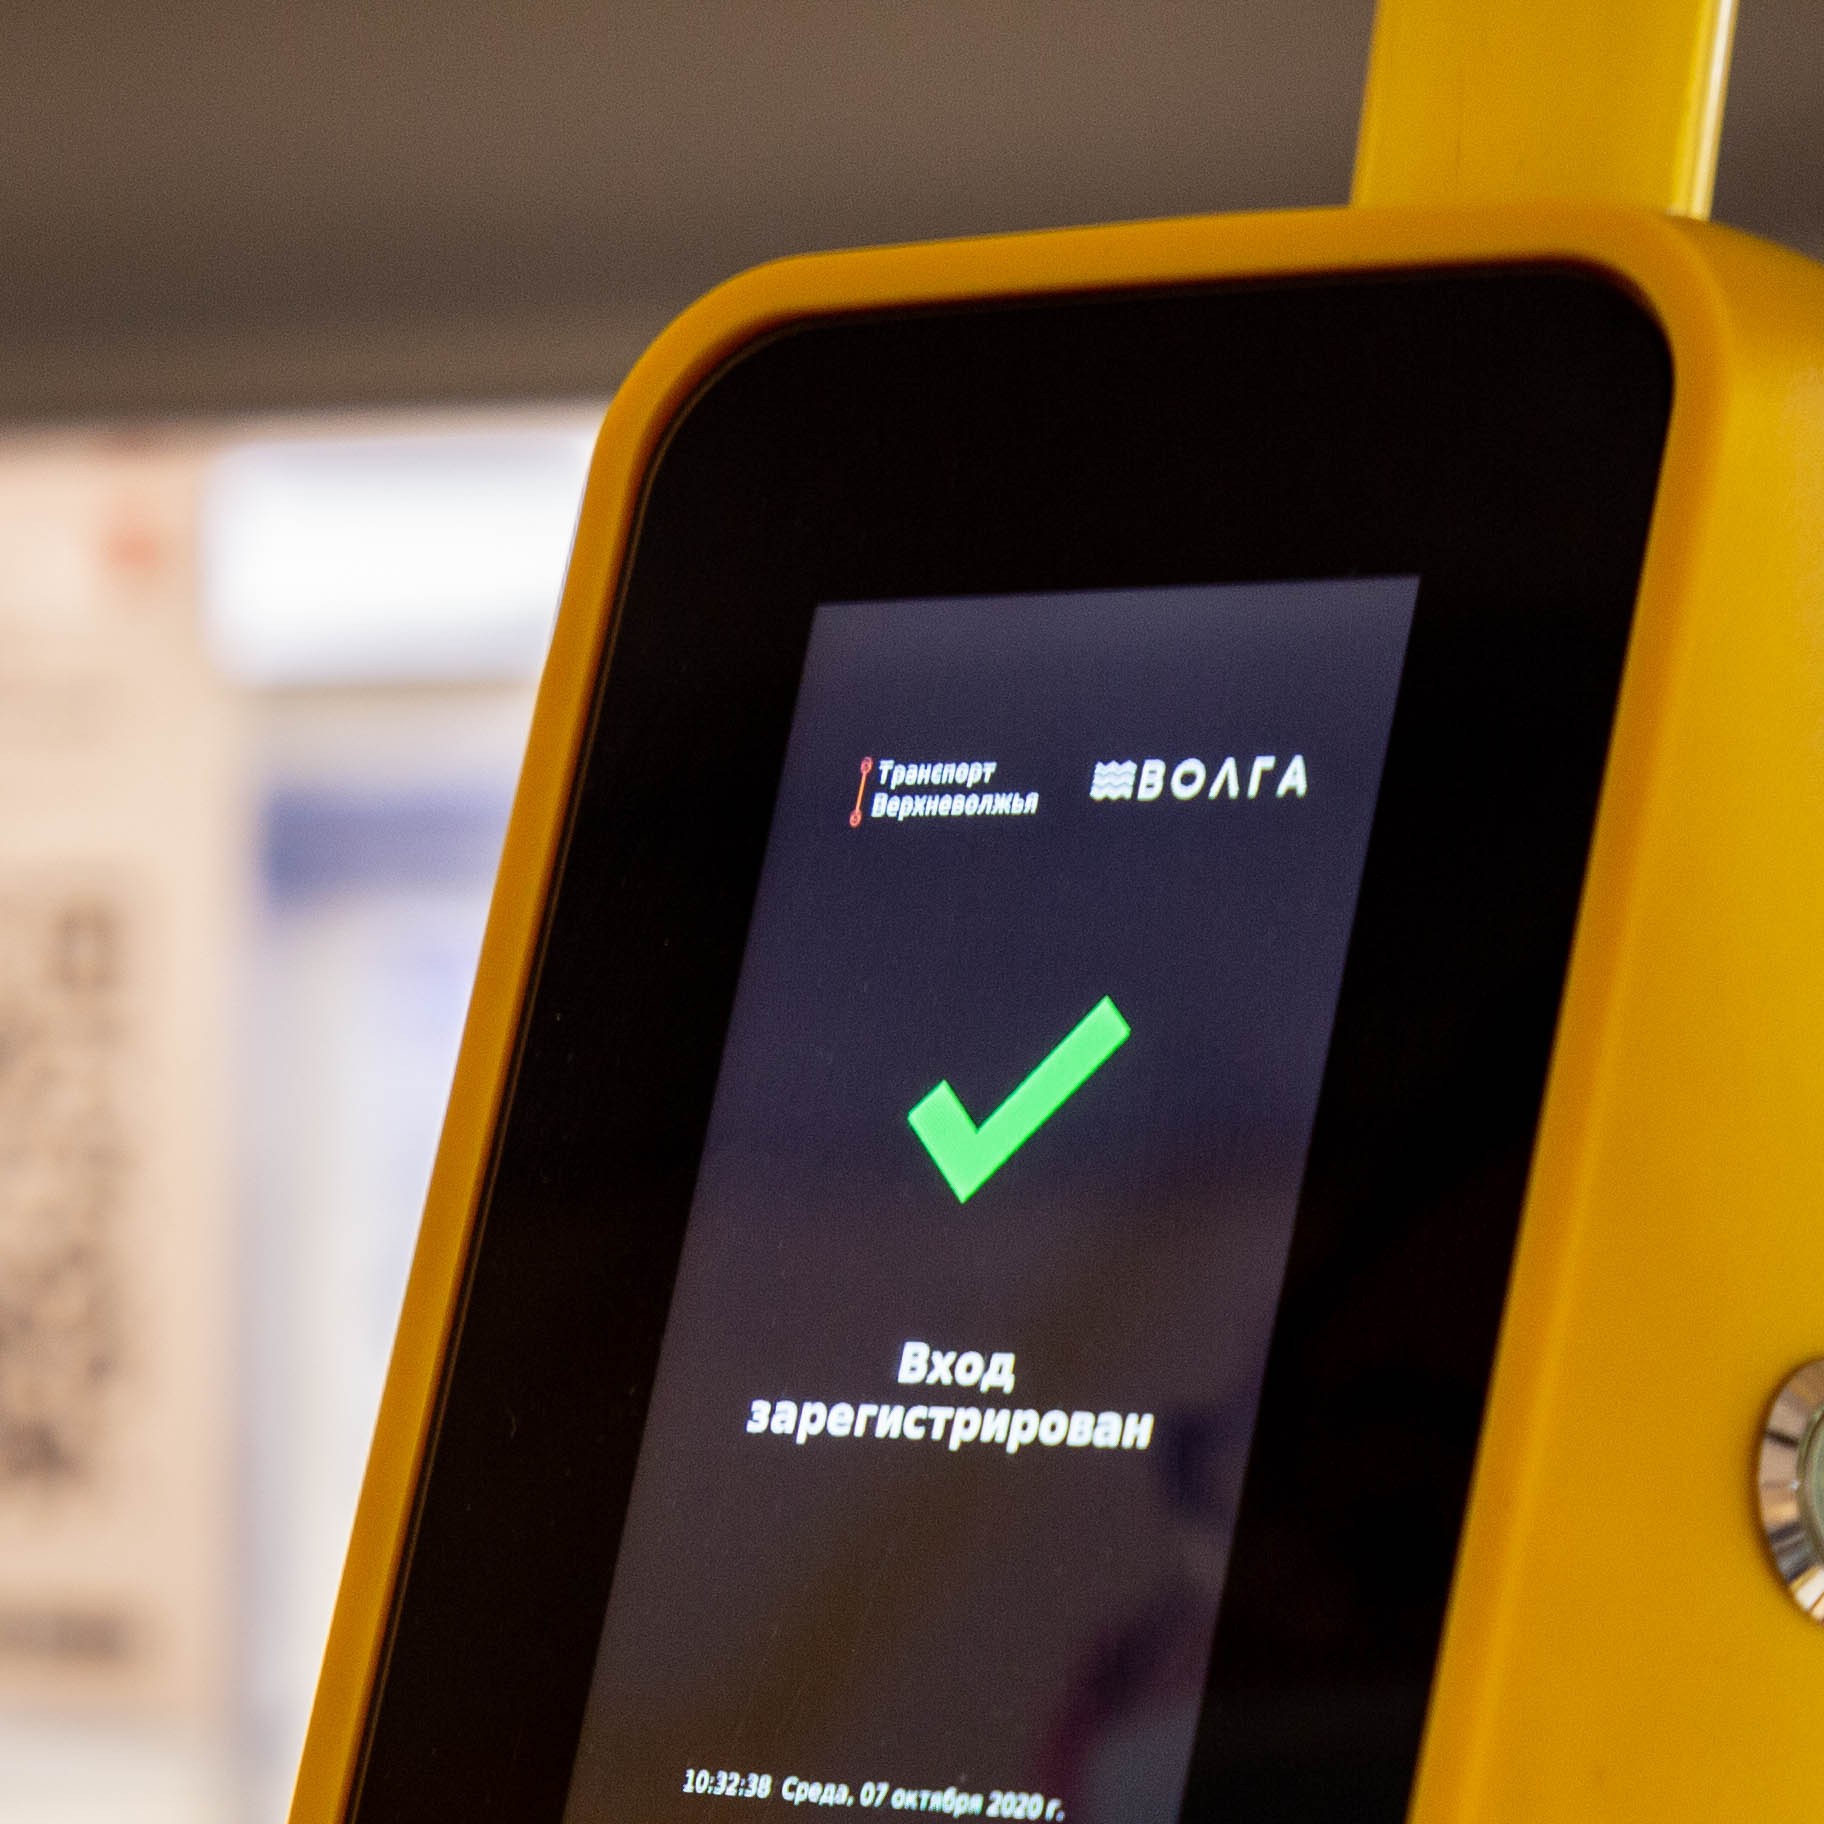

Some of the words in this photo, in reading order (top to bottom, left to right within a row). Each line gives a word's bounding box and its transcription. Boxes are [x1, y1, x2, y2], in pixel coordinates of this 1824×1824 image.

[879, 760, 997, 788] Транспорт
[1137, 755, 1308, 802] ВОЛГА
[871, 791, 1039, 821] Верхневолжья
[897, 1341, 1015, 1394] Вход
[746, 1399, 1154, 1455] зарегистрирован
[683, 1769, 772, 1799] 10:32:38
[781, 1776, 855, 1808] Среда,
[860, 1781, 889, 1807] 07
[891, 1786, 984, 1818] октября
[986, 1790, 1044, 1820] 2020
[1045, 1799, 1065, 1822] г.
